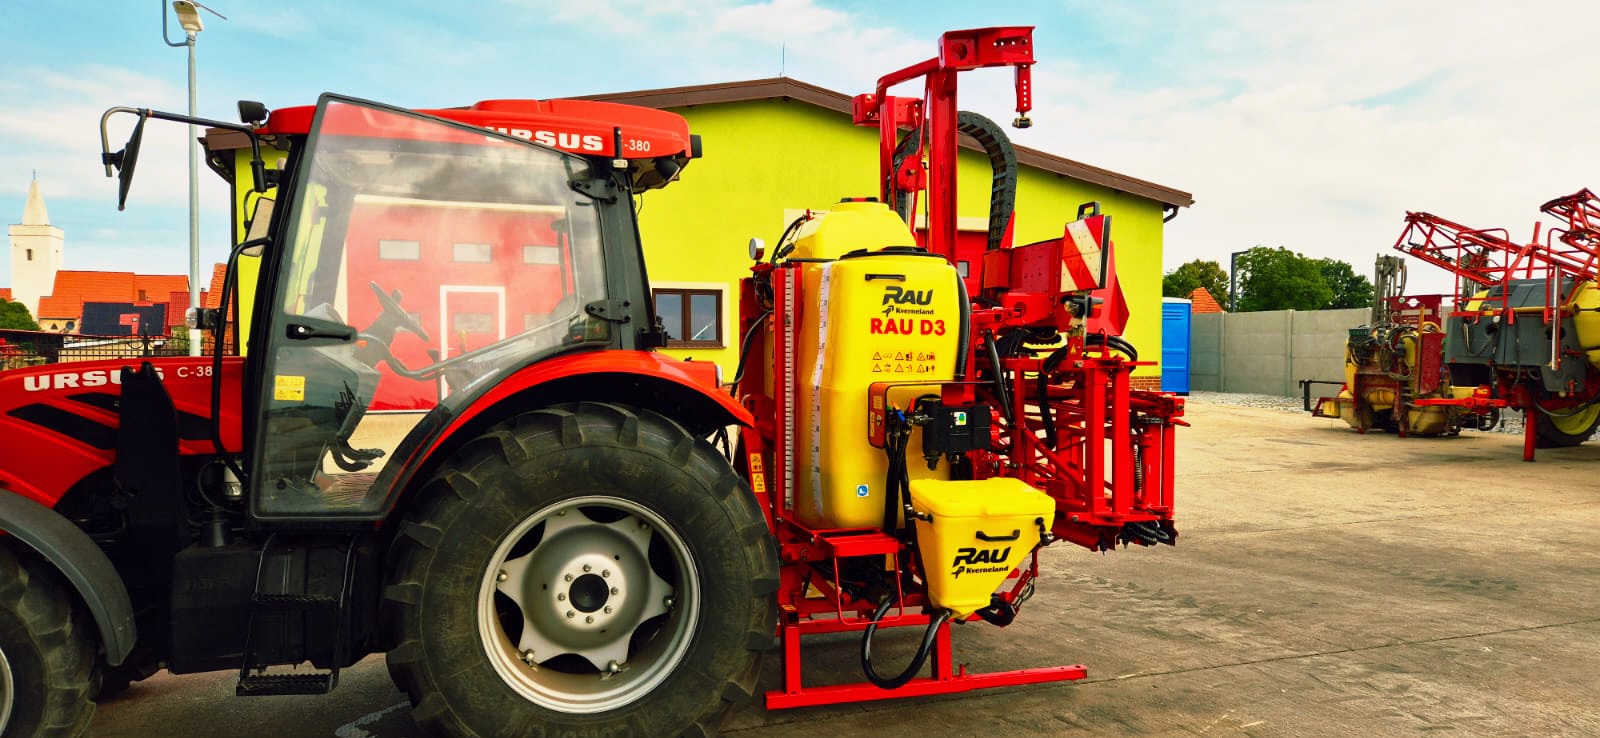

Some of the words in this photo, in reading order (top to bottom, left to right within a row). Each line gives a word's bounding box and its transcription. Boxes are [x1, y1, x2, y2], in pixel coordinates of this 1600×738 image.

[623, 139, 651, 152] -380
[882, 286, 934, 306] RAU
[896, 307, 935, 315] Kverneland
[870, 318, 914, 335] RAU
[920, 319, 946, 336] D3
[177, 366, 214, 378] C-38
[952, 546, 1011, 567] RAU
[966, 565, 1009, 574] Kverneland
